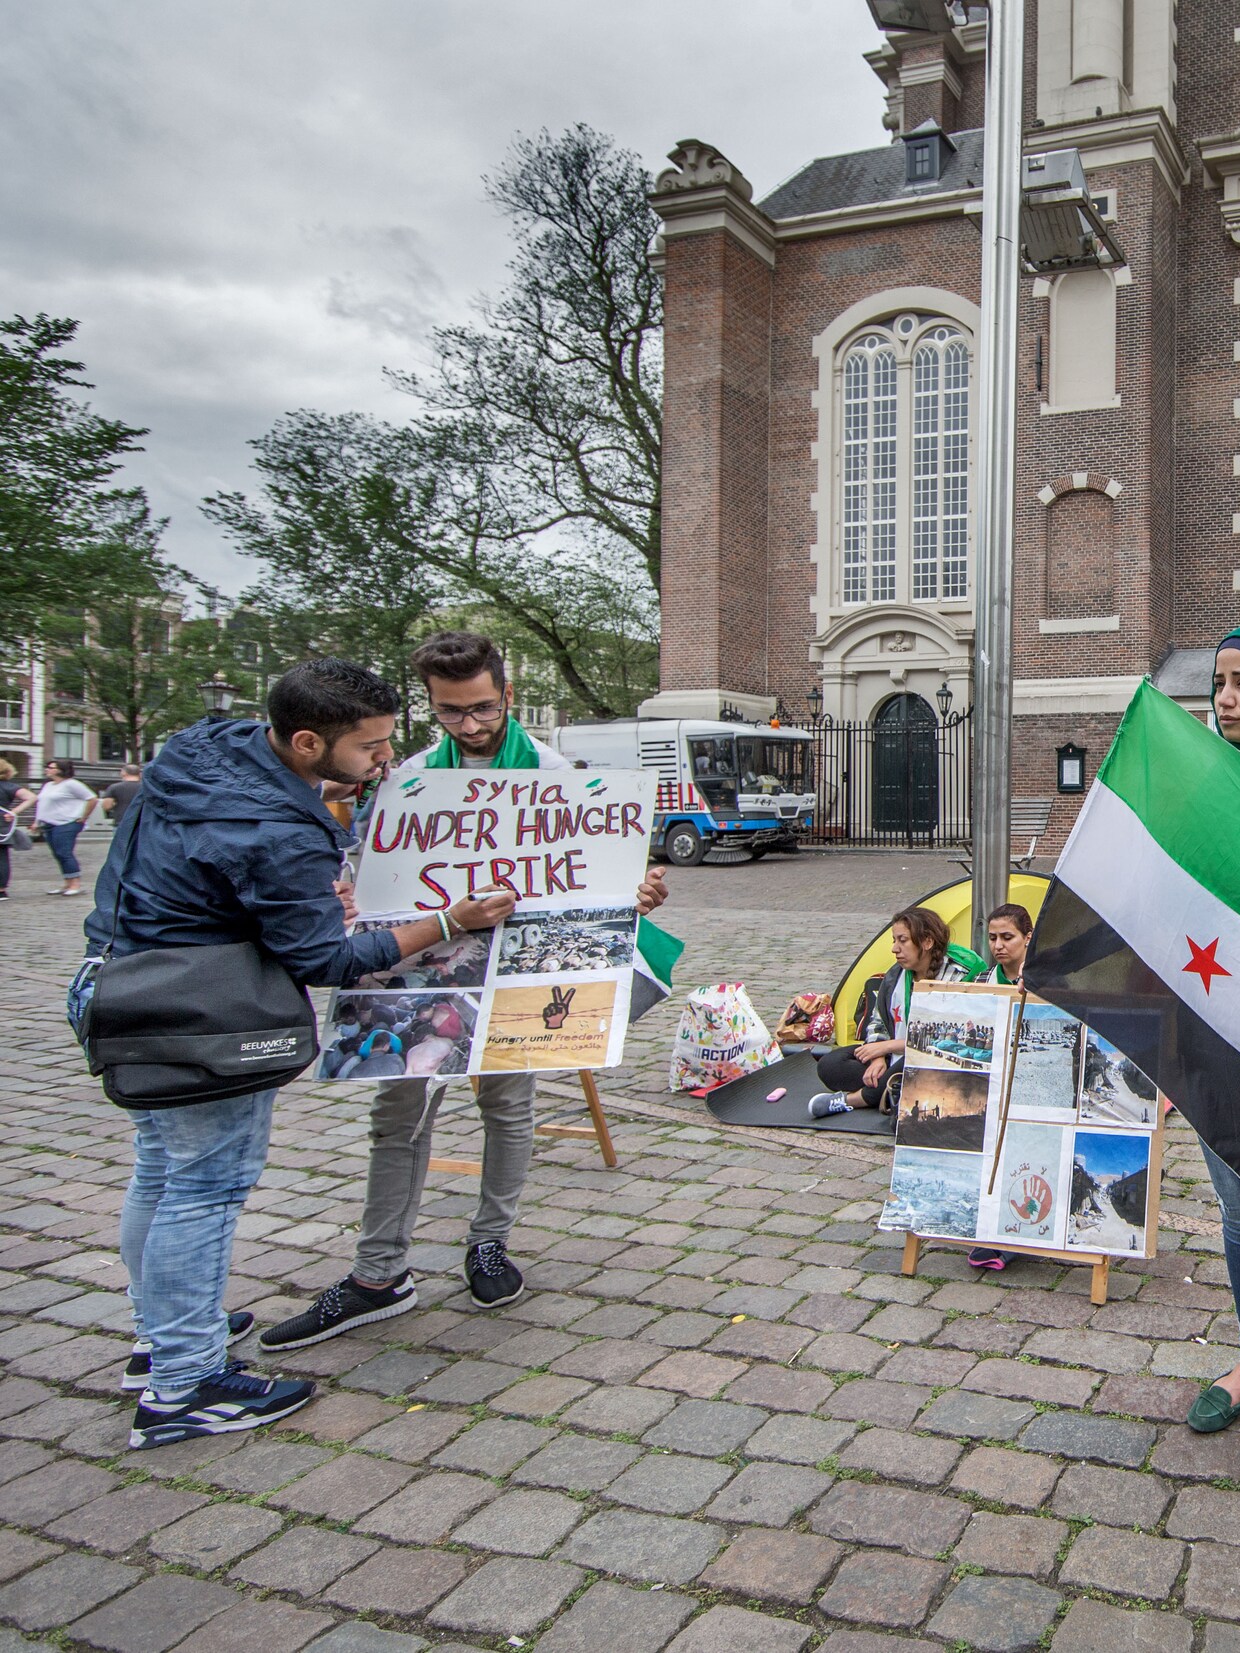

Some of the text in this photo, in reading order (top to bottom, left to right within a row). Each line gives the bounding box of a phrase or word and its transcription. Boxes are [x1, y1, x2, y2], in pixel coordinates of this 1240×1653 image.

[372, 802, 646, 853] UNDER HUNGER
[415, 849, 586, 911] STRIKE
[240, 1039, 289, 1051] BEEUWKES
[487, 1033, 604, 1045] Hungry until Freedom
[701, 1041, 746, 1062] ACTION
